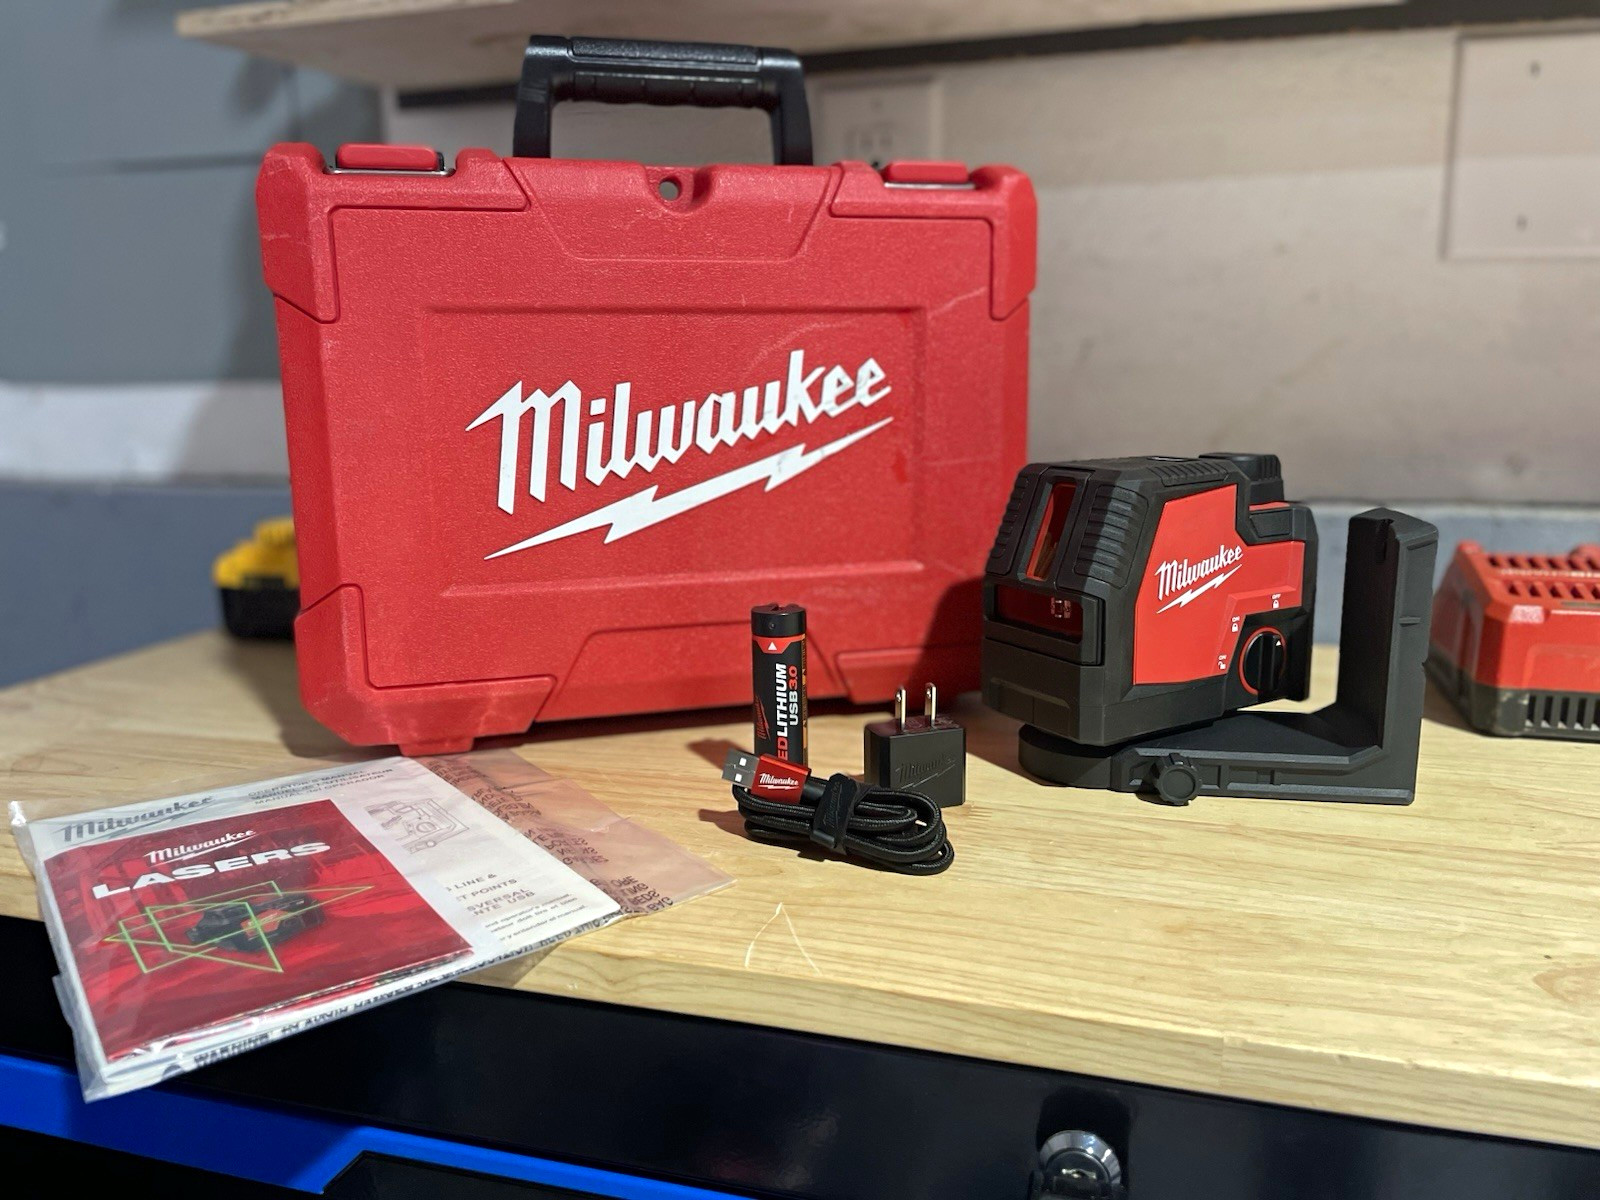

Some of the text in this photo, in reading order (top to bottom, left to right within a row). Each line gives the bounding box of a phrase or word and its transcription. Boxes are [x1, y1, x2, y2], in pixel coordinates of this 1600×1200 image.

[466, 349, 892, 514] Milwaukee
[1155, 544, 1244, 601] Milwaukee
[776, 662, 789, 760] EDLITHIUM
[759, 772, 799, 787] Milwaukee
[52, 796, 213, 841] Milwaukee
[142, 829, 256, 863] Milwaukee
[92, 842, 331, 900] LASERS
[454, 877, 485, 889] LINE
[471, 879, 517, 897] POINTS
[507, 891, 535, 904] USB
